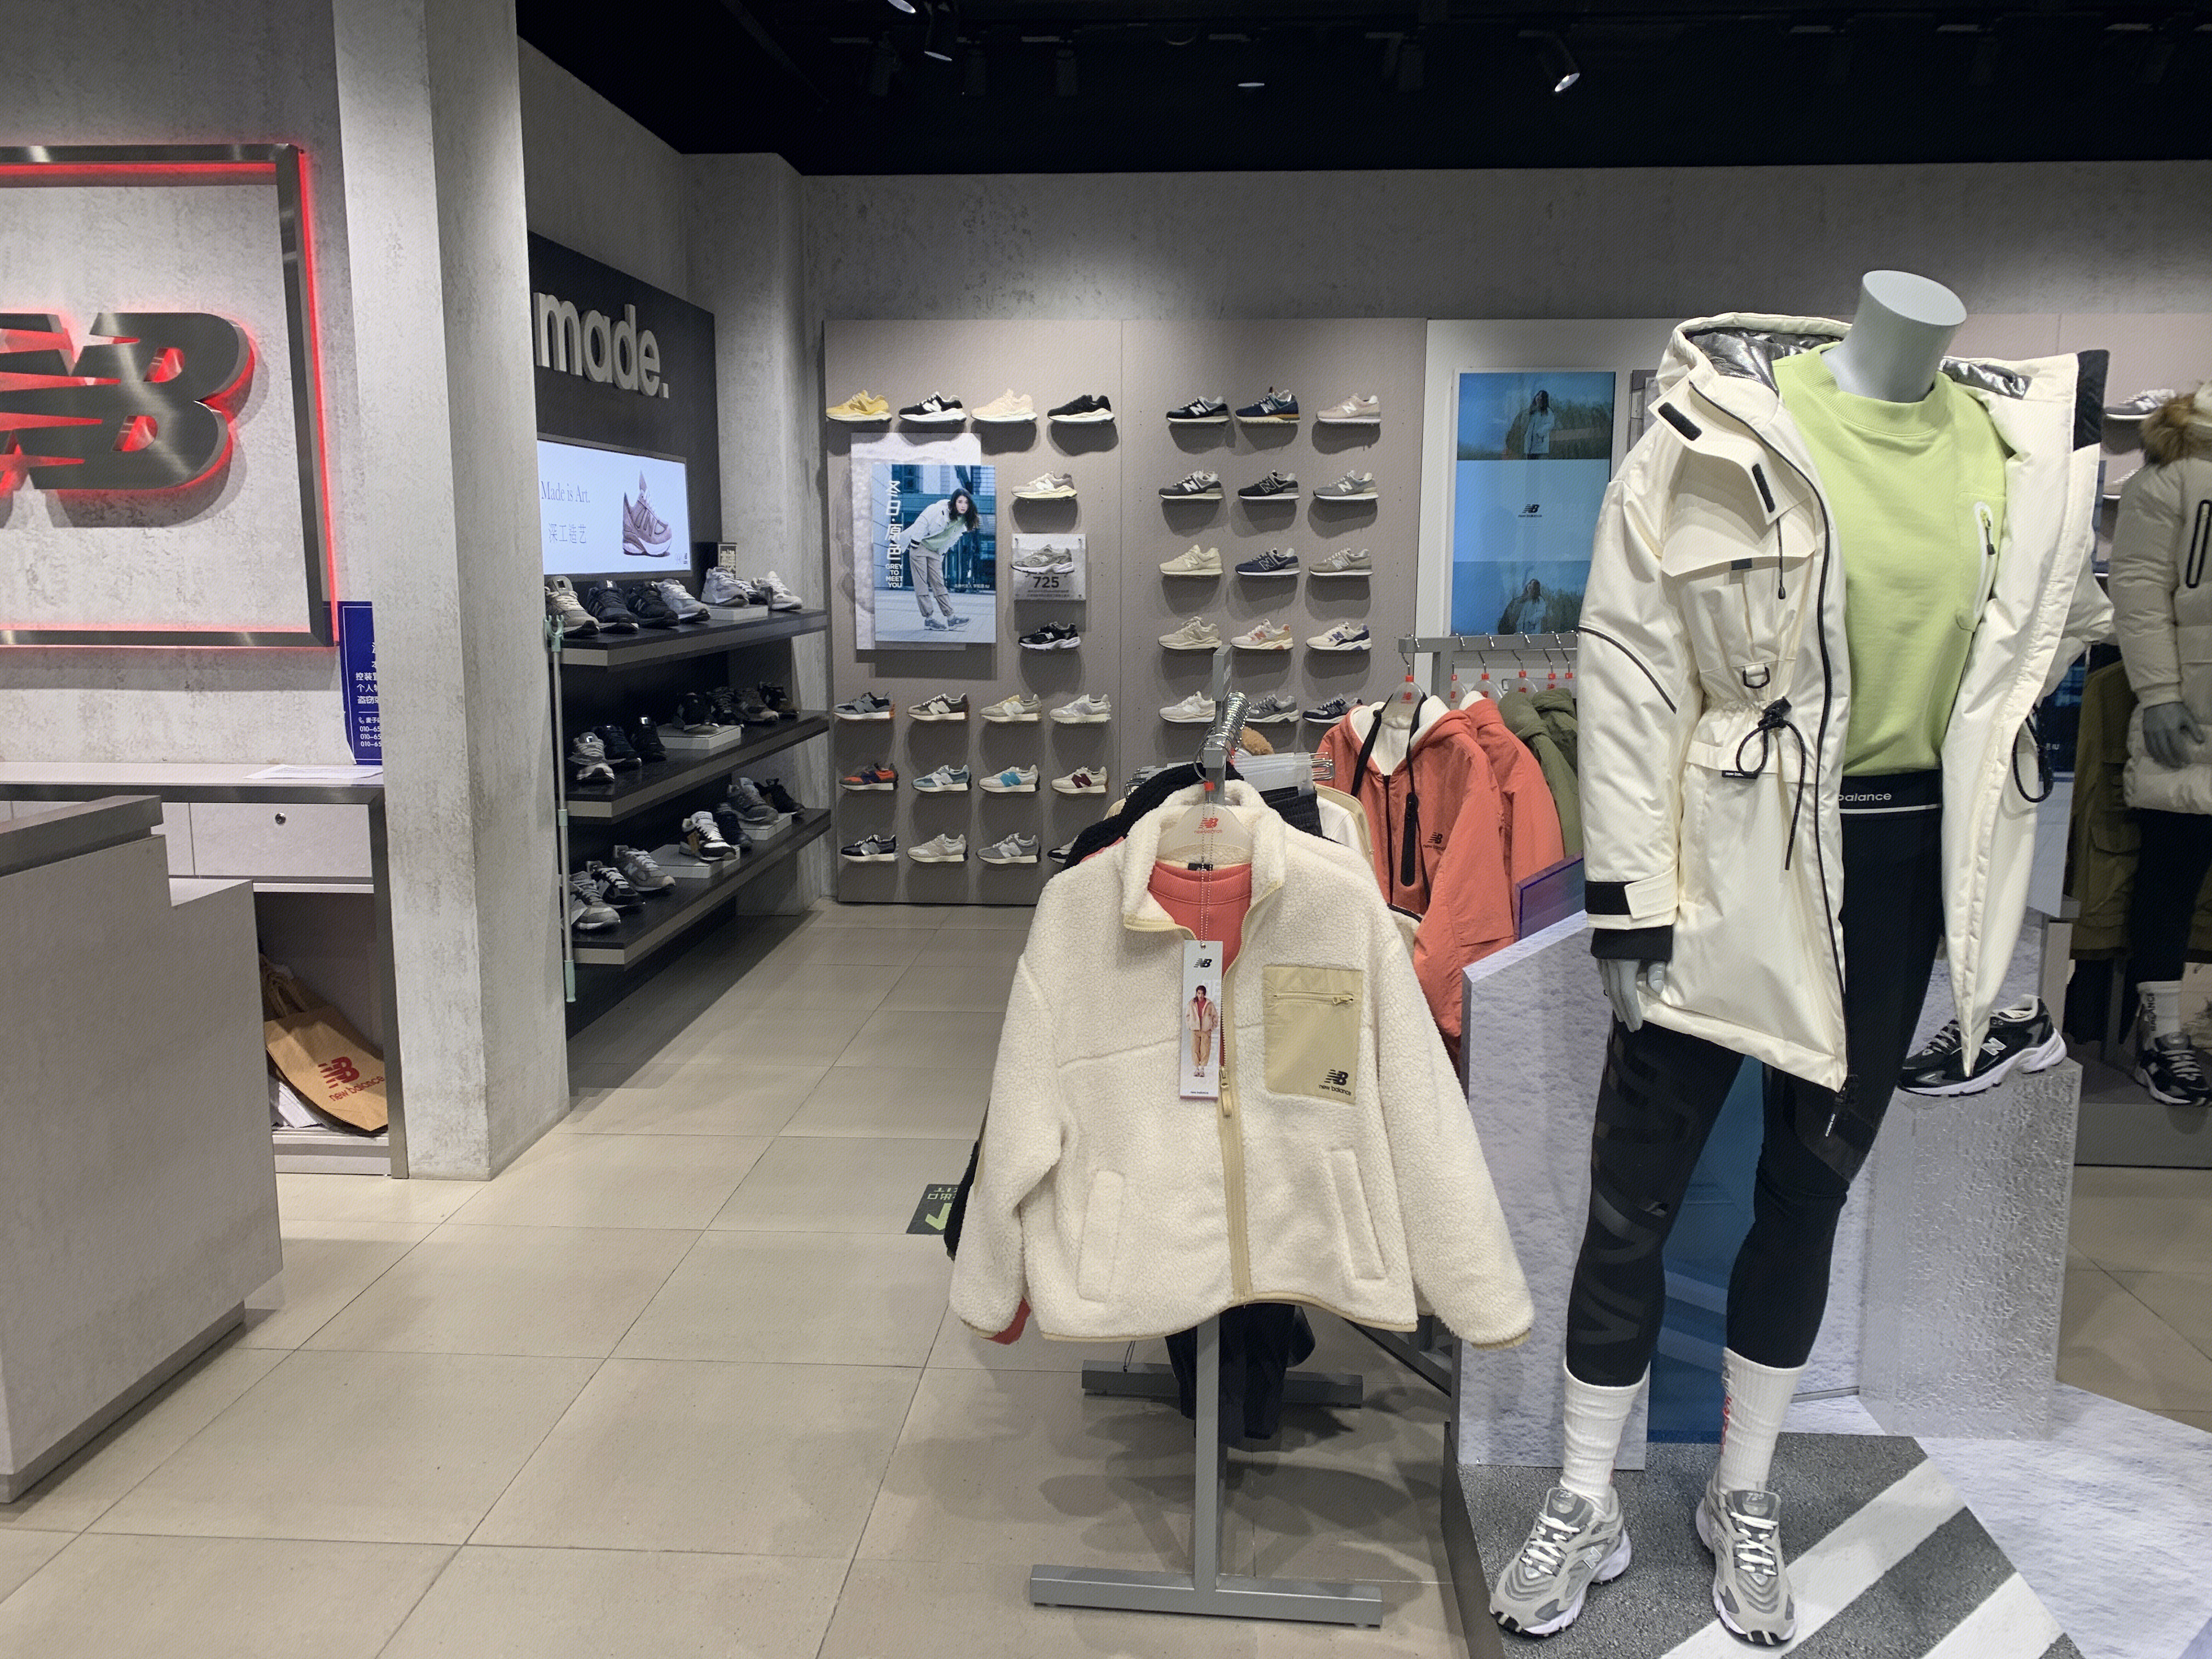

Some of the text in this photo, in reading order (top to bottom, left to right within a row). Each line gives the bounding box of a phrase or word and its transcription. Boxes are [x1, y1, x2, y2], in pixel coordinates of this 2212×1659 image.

[534, 292, 669, 399] made.
[923, 399, 941, 412] N
[1190, 403, 1206, 415] N
[1261, 400, 1276, 413] N
[1342, 402, 1357, 414] N
[541, 481, 590, 503] Made is Art.
[1183, 481, 1199, 492] N
[1260, 479, 1277, 493] N
[1338, 481, 1353, 492] N
[548, 522, 586, 544] 深工造艺
[1259, 558, 1275, 570] N
[1331, 556, 1348, 569] N
[1033, 577, 1059, 588] 725
[1332, 632, 1344, 640] N
[1071, 773, 1092, 788] N
[1980, 1037, 2007, 1056] N
[329, 1076, 385, 1102] new balance
[1331, 1086, 1351, 1096] balance
[1583, 1546, 1602, 1570] N
